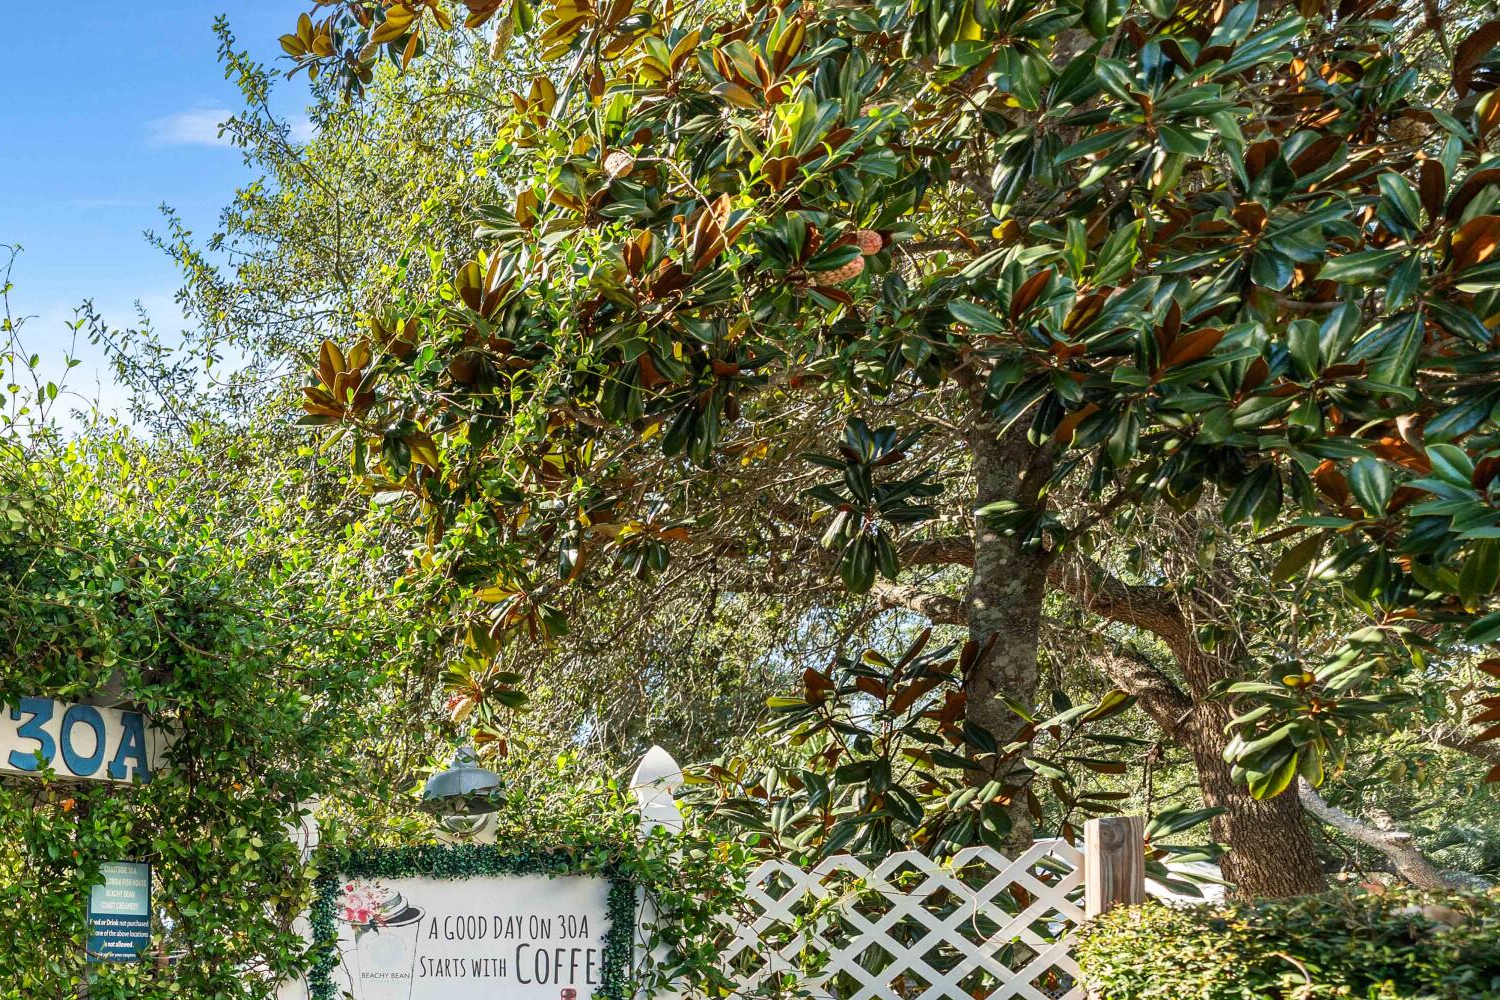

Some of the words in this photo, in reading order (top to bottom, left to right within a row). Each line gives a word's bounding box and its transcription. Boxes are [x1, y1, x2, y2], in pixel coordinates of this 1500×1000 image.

[8, 696, 150, 784] 30A
[130, 930, 149, 938] locations
[428, 916, 438, 939] A
[444, 915, 488, 940] GOOD
[493, 915, 523, 939] DAY
[557, 914, 589, 939] 30A
[419, 955, 466, 978] STARTS
[471, 957, 507, 977] WITH
